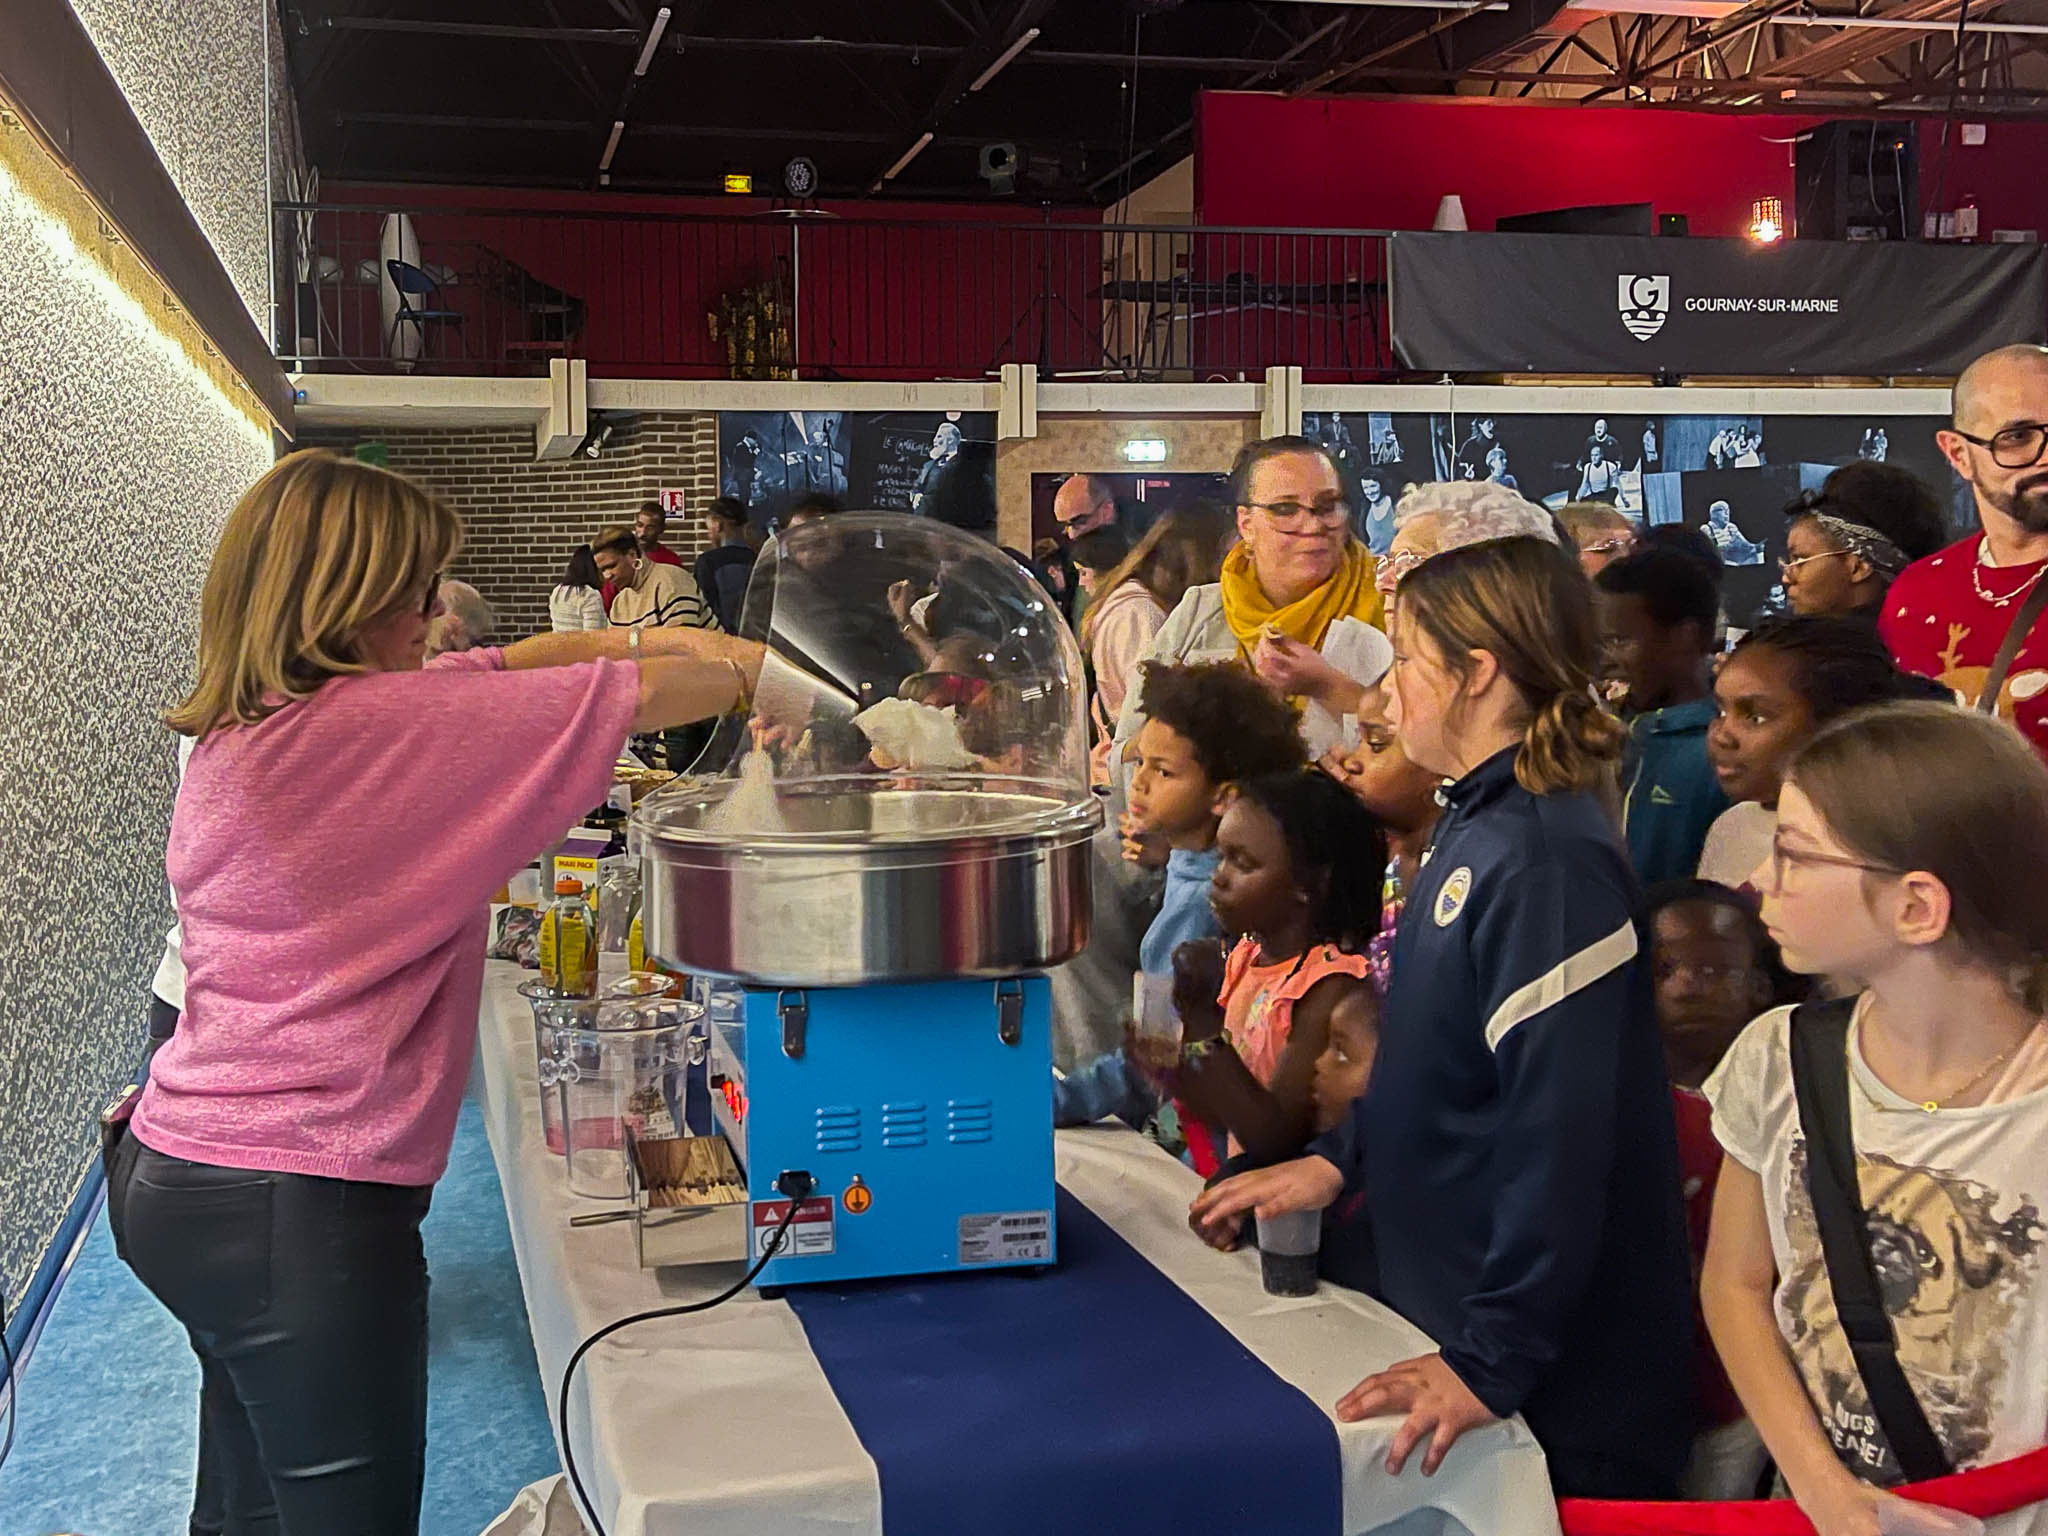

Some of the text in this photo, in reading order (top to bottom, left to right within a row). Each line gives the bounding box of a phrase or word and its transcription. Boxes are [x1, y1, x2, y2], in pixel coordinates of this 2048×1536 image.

[1685, 297, 1839, 313] GOURNAY-SUR-MARNE
[558, 860, 594, 869] MAXI PACK
